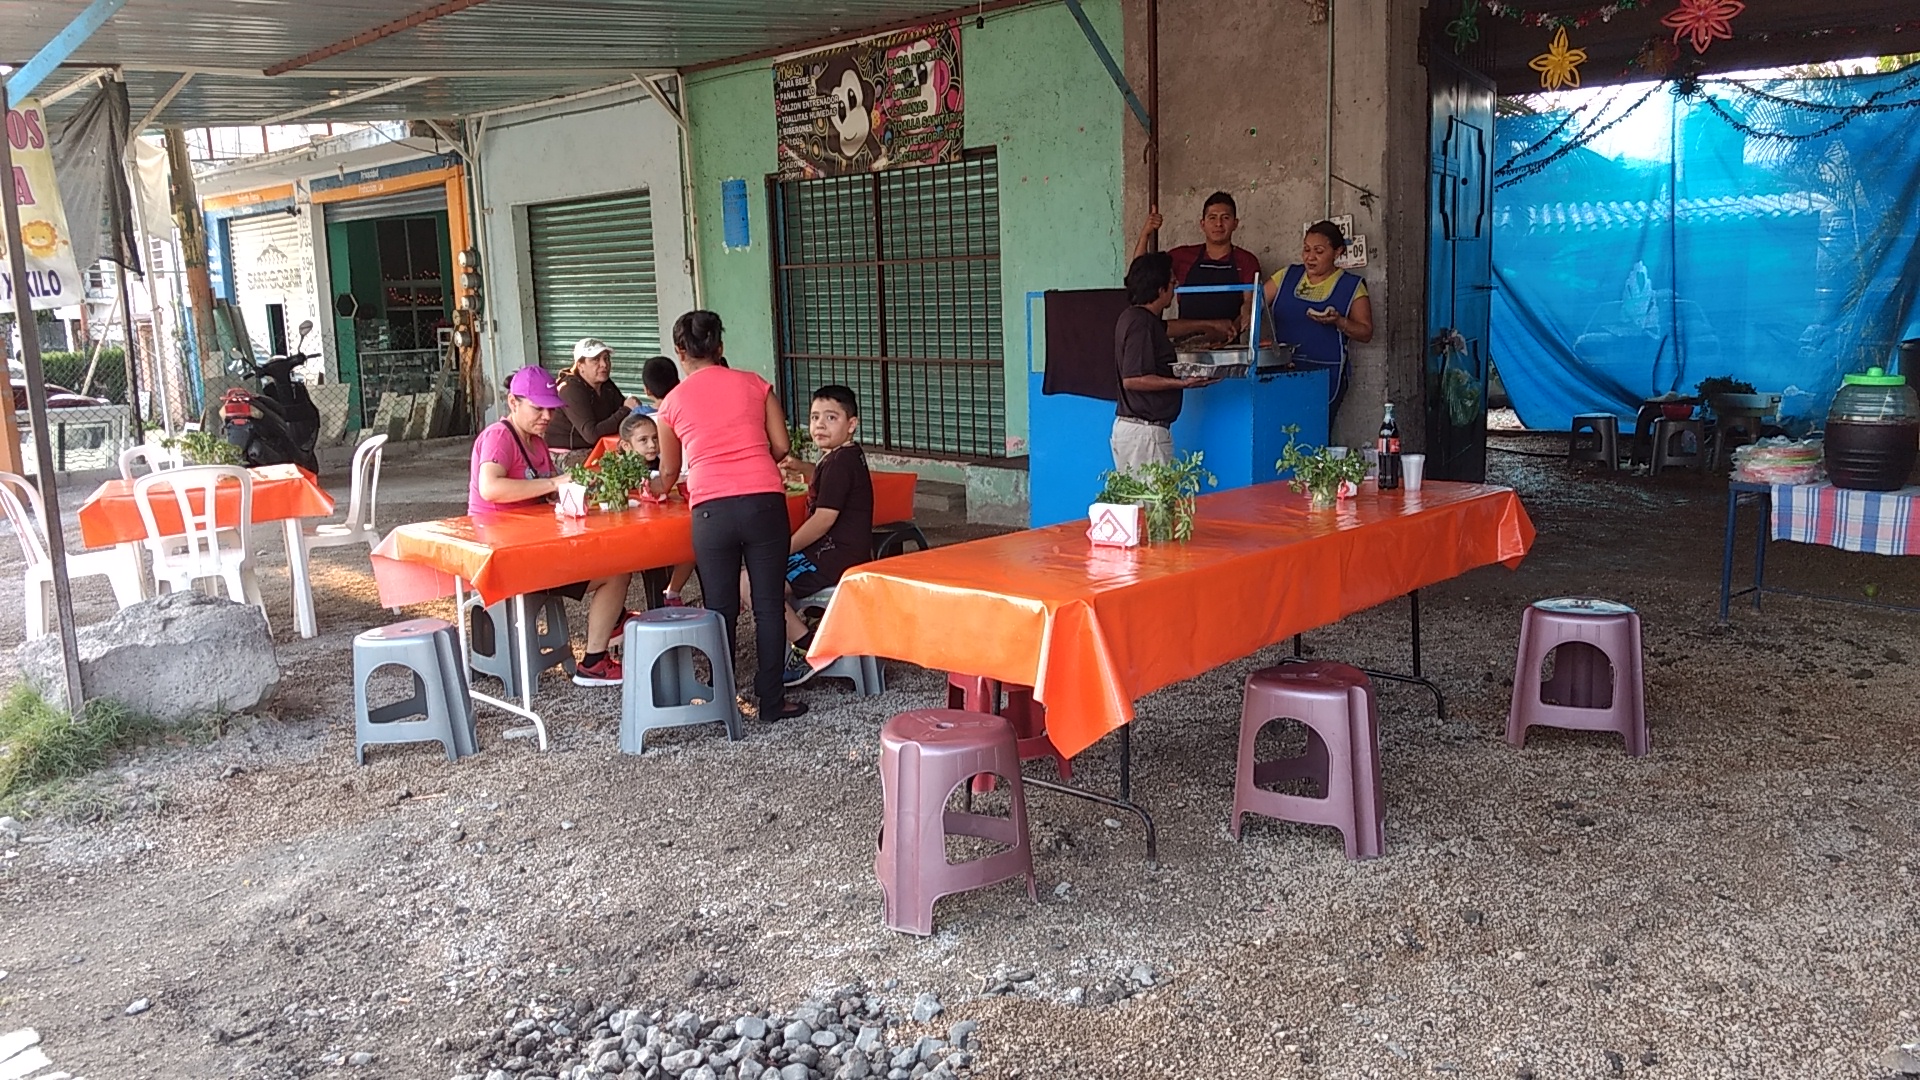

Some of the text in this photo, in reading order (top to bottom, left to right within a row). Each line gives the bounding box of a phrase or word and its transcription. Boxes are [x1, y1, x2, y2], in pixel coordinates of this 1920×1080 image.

[888, 55, 910, 68] PARA
[780, 79, 794, 89] PARA
[780, 89, 797, 101] PAÑAL
[780, 95, 839, 112] CALZON ENTRENADOR
[782, 112, 808, 124] TOALLITAS
[783, 124, 813, 136] BIBERONES
